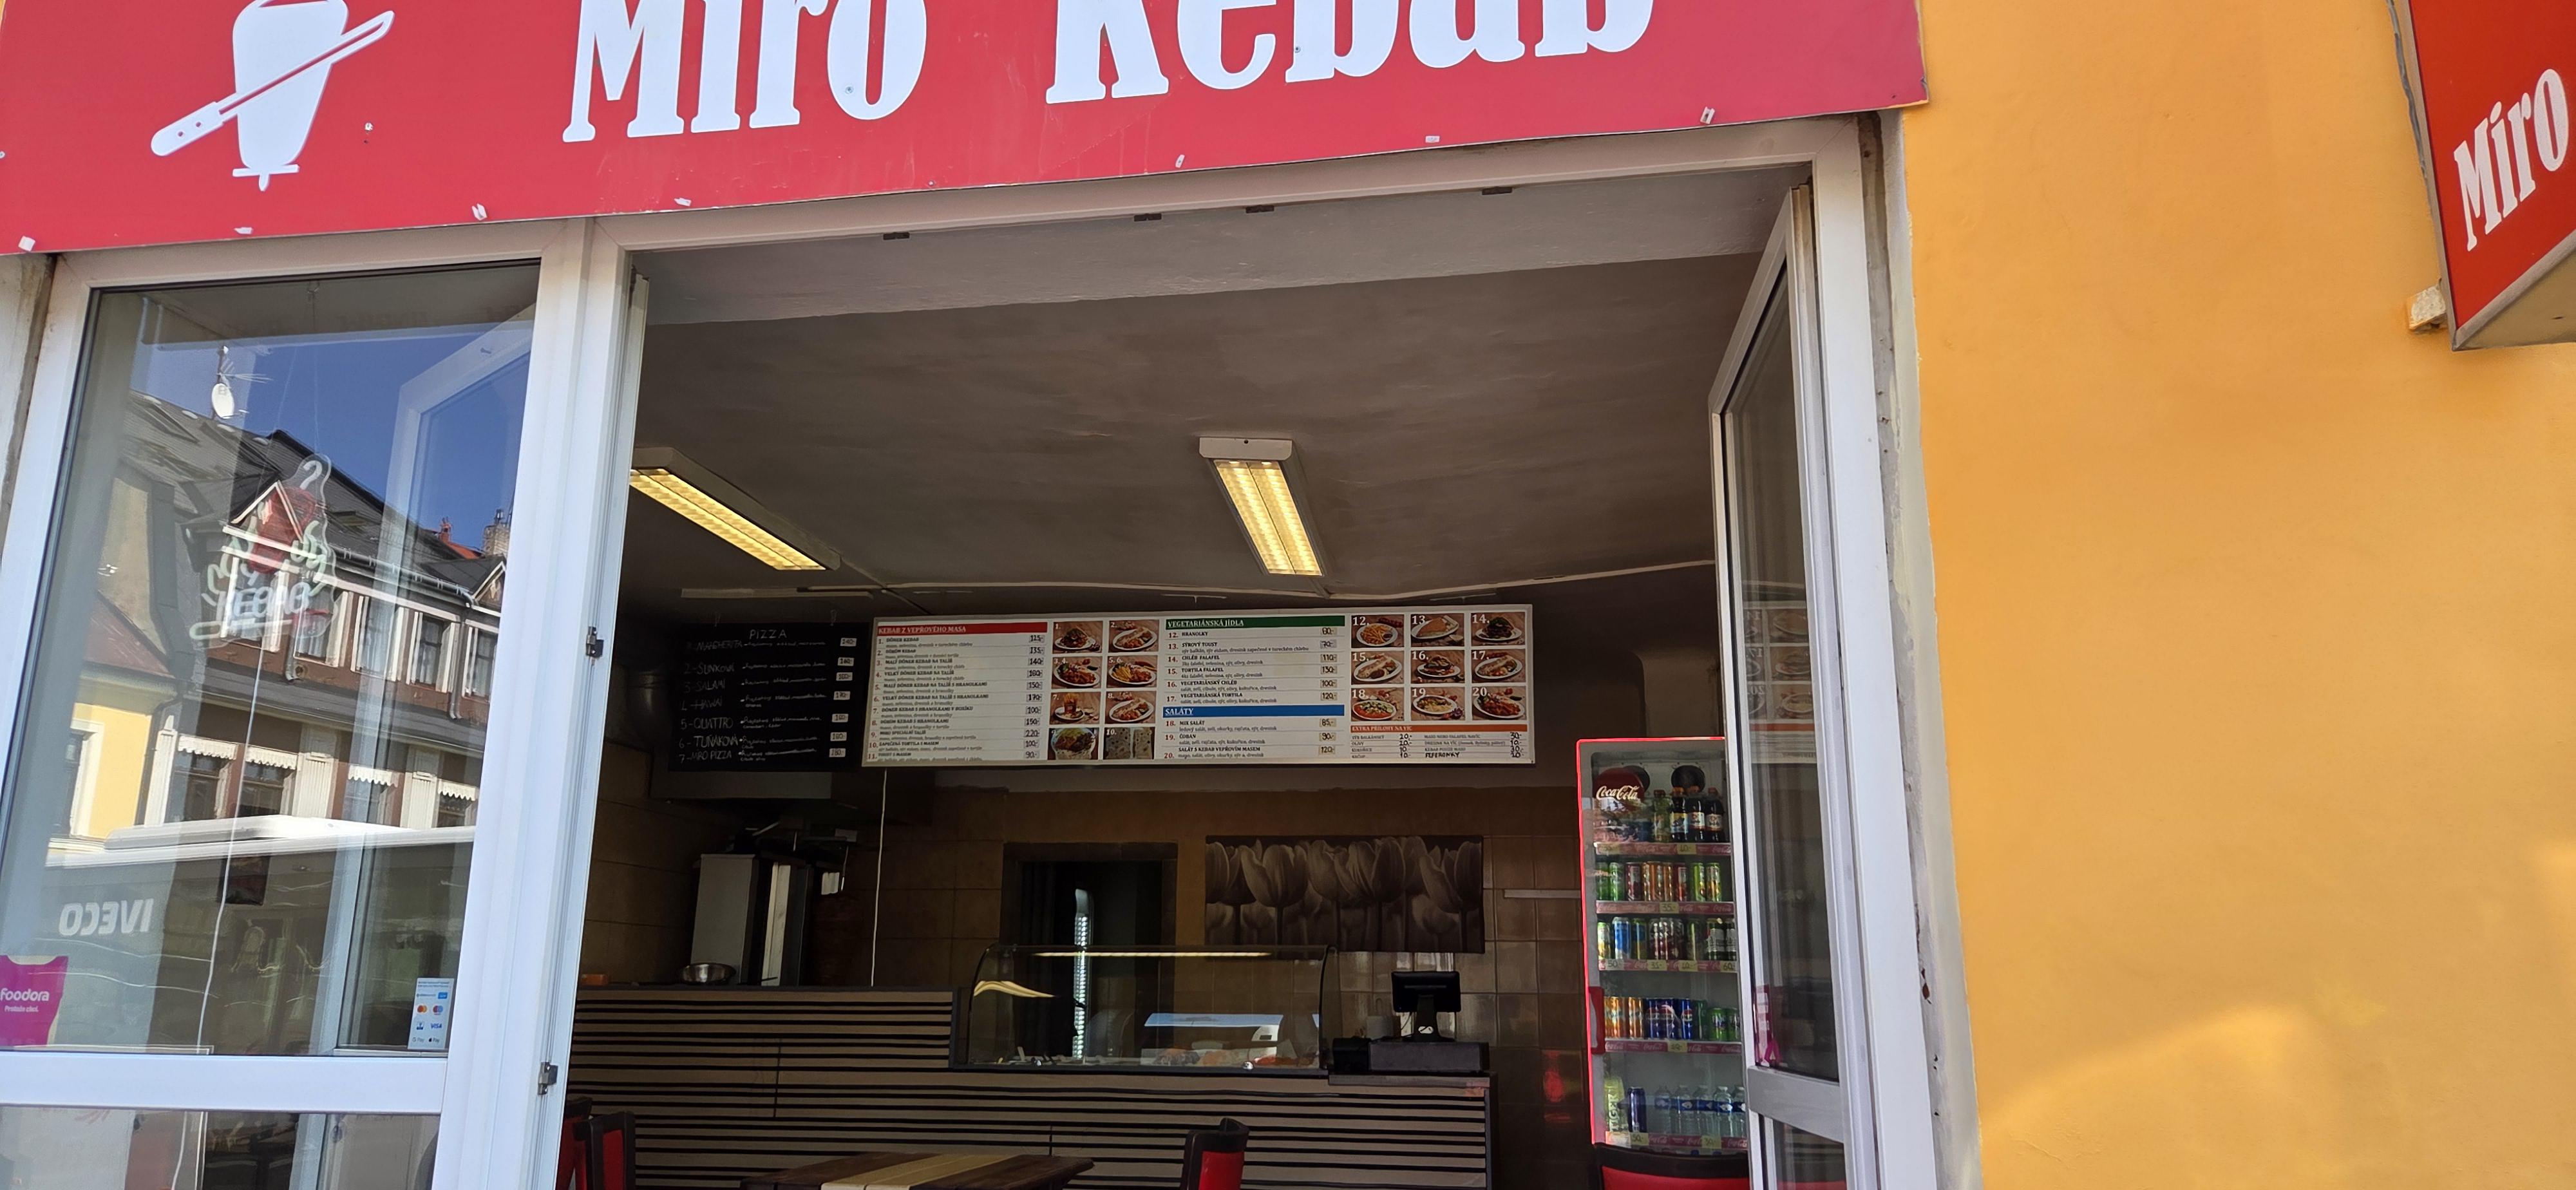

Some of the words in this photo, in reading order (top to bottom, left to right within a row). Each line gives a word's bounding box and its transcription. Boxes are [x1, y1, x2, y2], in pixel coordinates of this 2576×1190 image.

[562, 0, 927, 143] Miro
[2454, 68, 2570, 252] Miro
[1168, 619, 1224, 627] VEGETARIÁNSKÁ
[1225, 618, 1244, 627] JÍDLA
[1352, 616, 1370, 626] 12.
[1472, 613, 1490, 623] 14.
[749, 629, 787, 639] PIZZA
[1352, 652, 1370, 662] 15.
[1412, 650, 1429, 660] 16.
[1472, 650, 1490, 660] 17.
[1352, 689, 1369, 699] 18.
[1472, 687, 1491, 697] 20.
[1164, 708, 1194, 716] SALÁTY
[0, 988, 50, 1001] foodora
